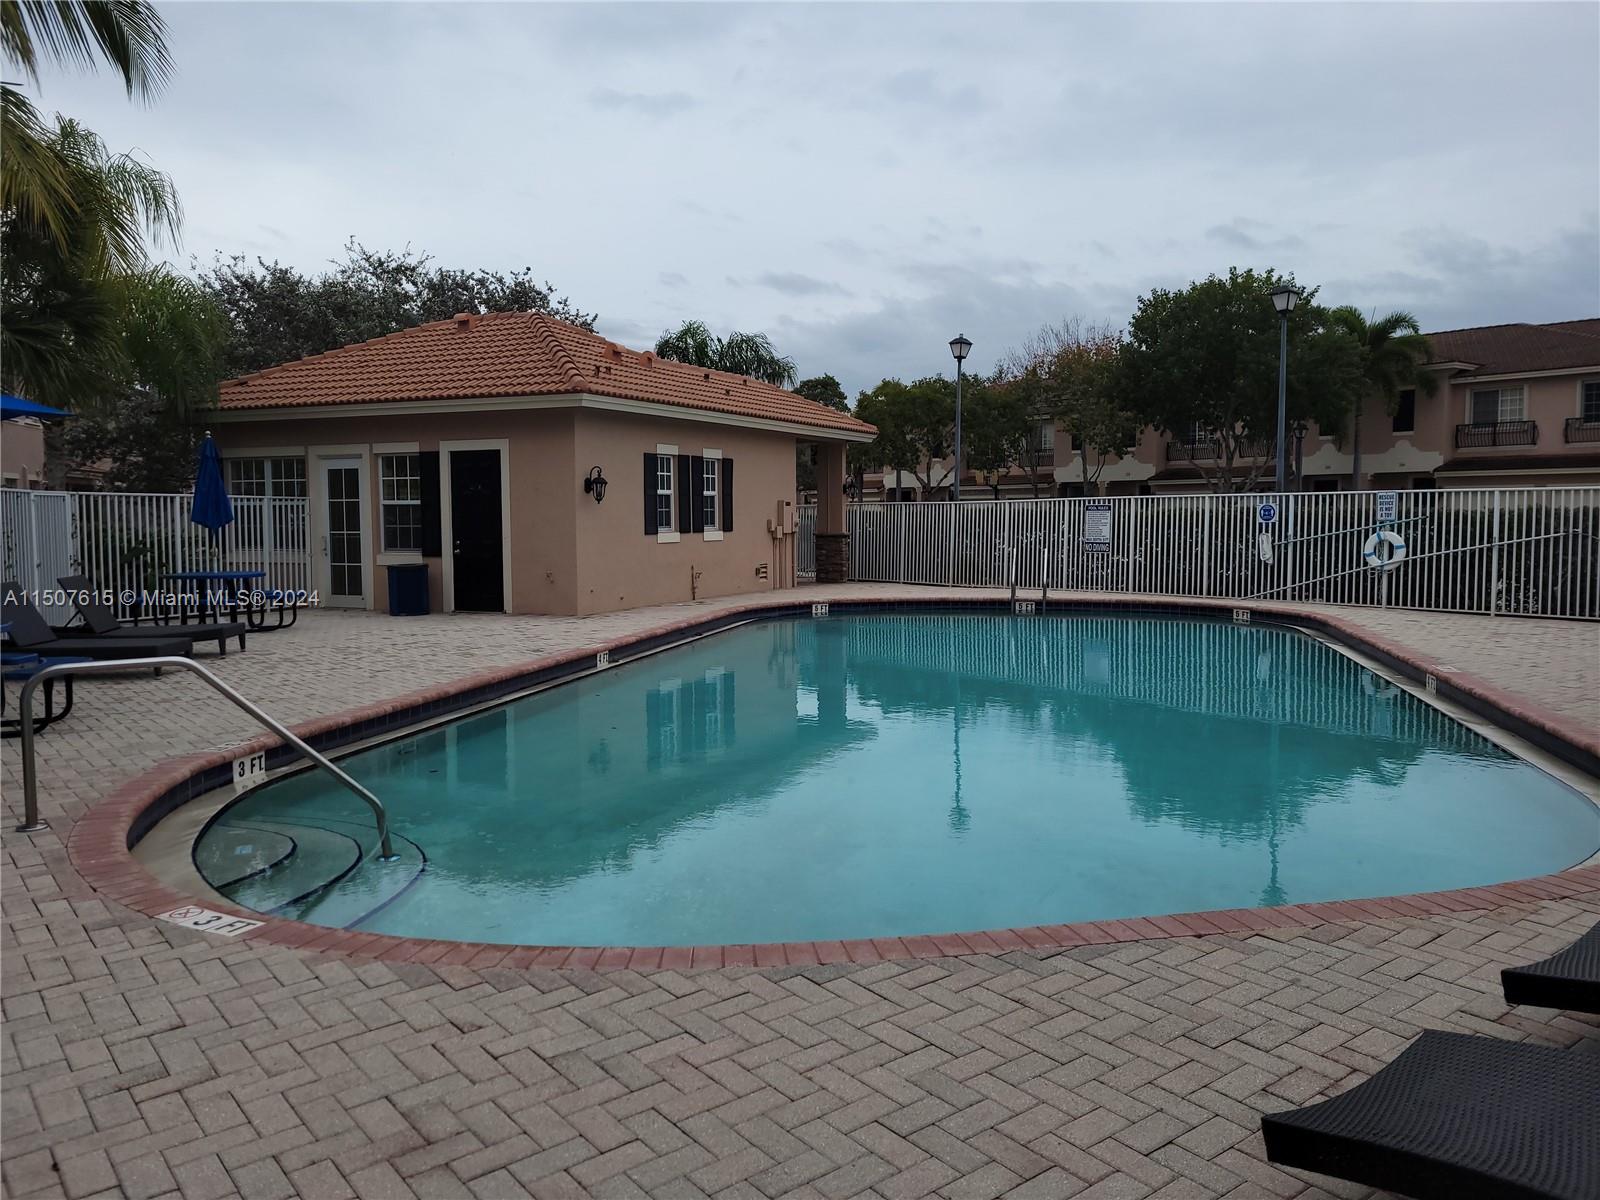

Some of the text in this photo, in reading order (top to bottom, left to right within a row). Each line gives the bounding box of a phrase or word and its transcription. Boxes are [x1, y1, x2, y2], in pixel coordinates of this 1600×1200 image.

[1085, 543, 1110, 552] NO DIVING
[1018, 602, 1034, 612] 5 FT
[238, 760, 245, 778] 3
[192, 915, 257, 933] 3 FT
